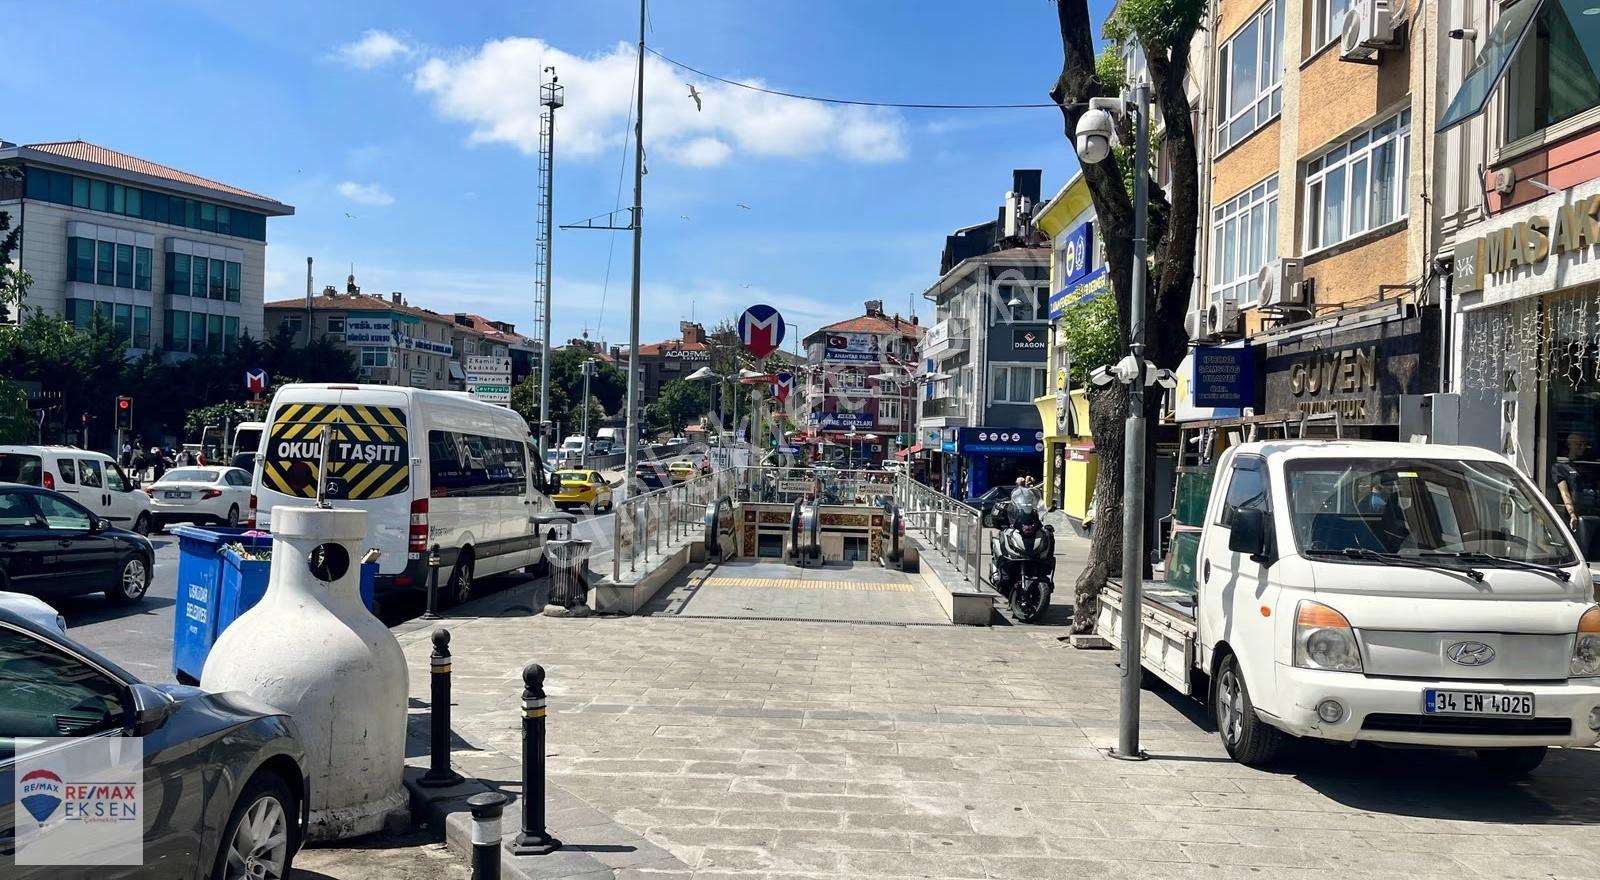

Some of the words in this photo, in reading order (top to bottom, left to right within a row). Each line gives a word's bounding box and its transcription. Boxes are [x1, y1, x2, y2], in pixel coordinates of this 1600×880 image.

[1289, 344, 1377, 397] GÜVEN
[278, 442, 322, 459] OKUL
[339, 443, 401, 464] TAŞITI
[1436, 693, 1457, 711] 34
[1463, 694, 1484, 712] EN
[1491, 695, 1531, 713] 4026
